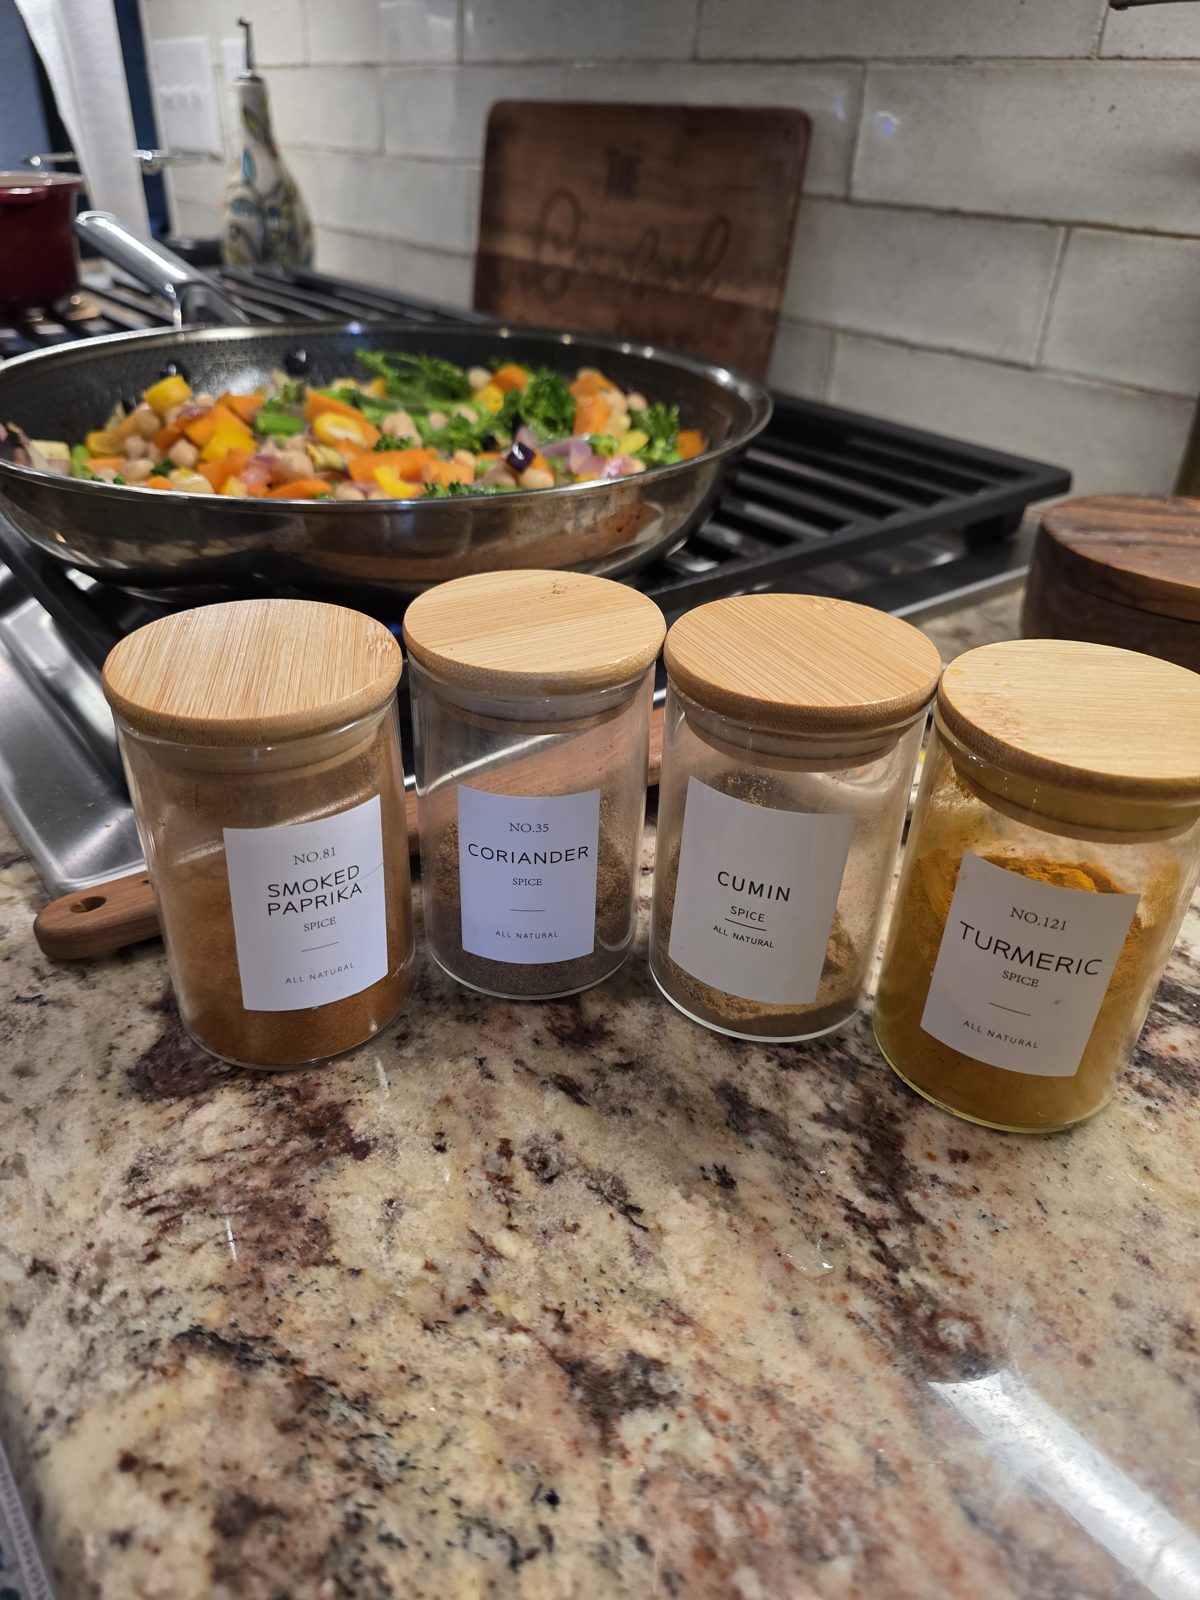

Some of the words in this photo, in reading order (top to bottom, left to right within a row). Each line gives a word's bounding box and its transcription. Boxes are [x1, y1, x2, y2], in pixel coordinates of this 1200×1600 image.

[509, 822, 549, 833] NO.35
[293, 846, 336, 866] NO.81
[468, 843, 589, 865] CORIANDER
[267, 865, 360, 898] SMOKED
[512, 877, 543, 886] SPICE
[717, 871, 791, 902] CUMIN
[267, 882, 362, 916] PAPRIKA
[303, 916, 337, 932] SPICE
[729, 905, 765, 923] SPICE
[1009, 906, 1067, 931] NO.121
[495, 930, 511, 938] ALL
[516, 931, 558, 939] NATURAL
[712, 925, 728, 936] ALL
[732, 932, 774, 949] NATURAL
[959, 920, 1103, 976] TURMERIC
[285, 975, 304, 985] ALL
[309, 962, 355, 981] NATURAL
[1001, 970, 1040, 988] SPICE
[963, 1020, 982, 1033] ALL
[987, 1029, 1038, 1049] NATURAL
